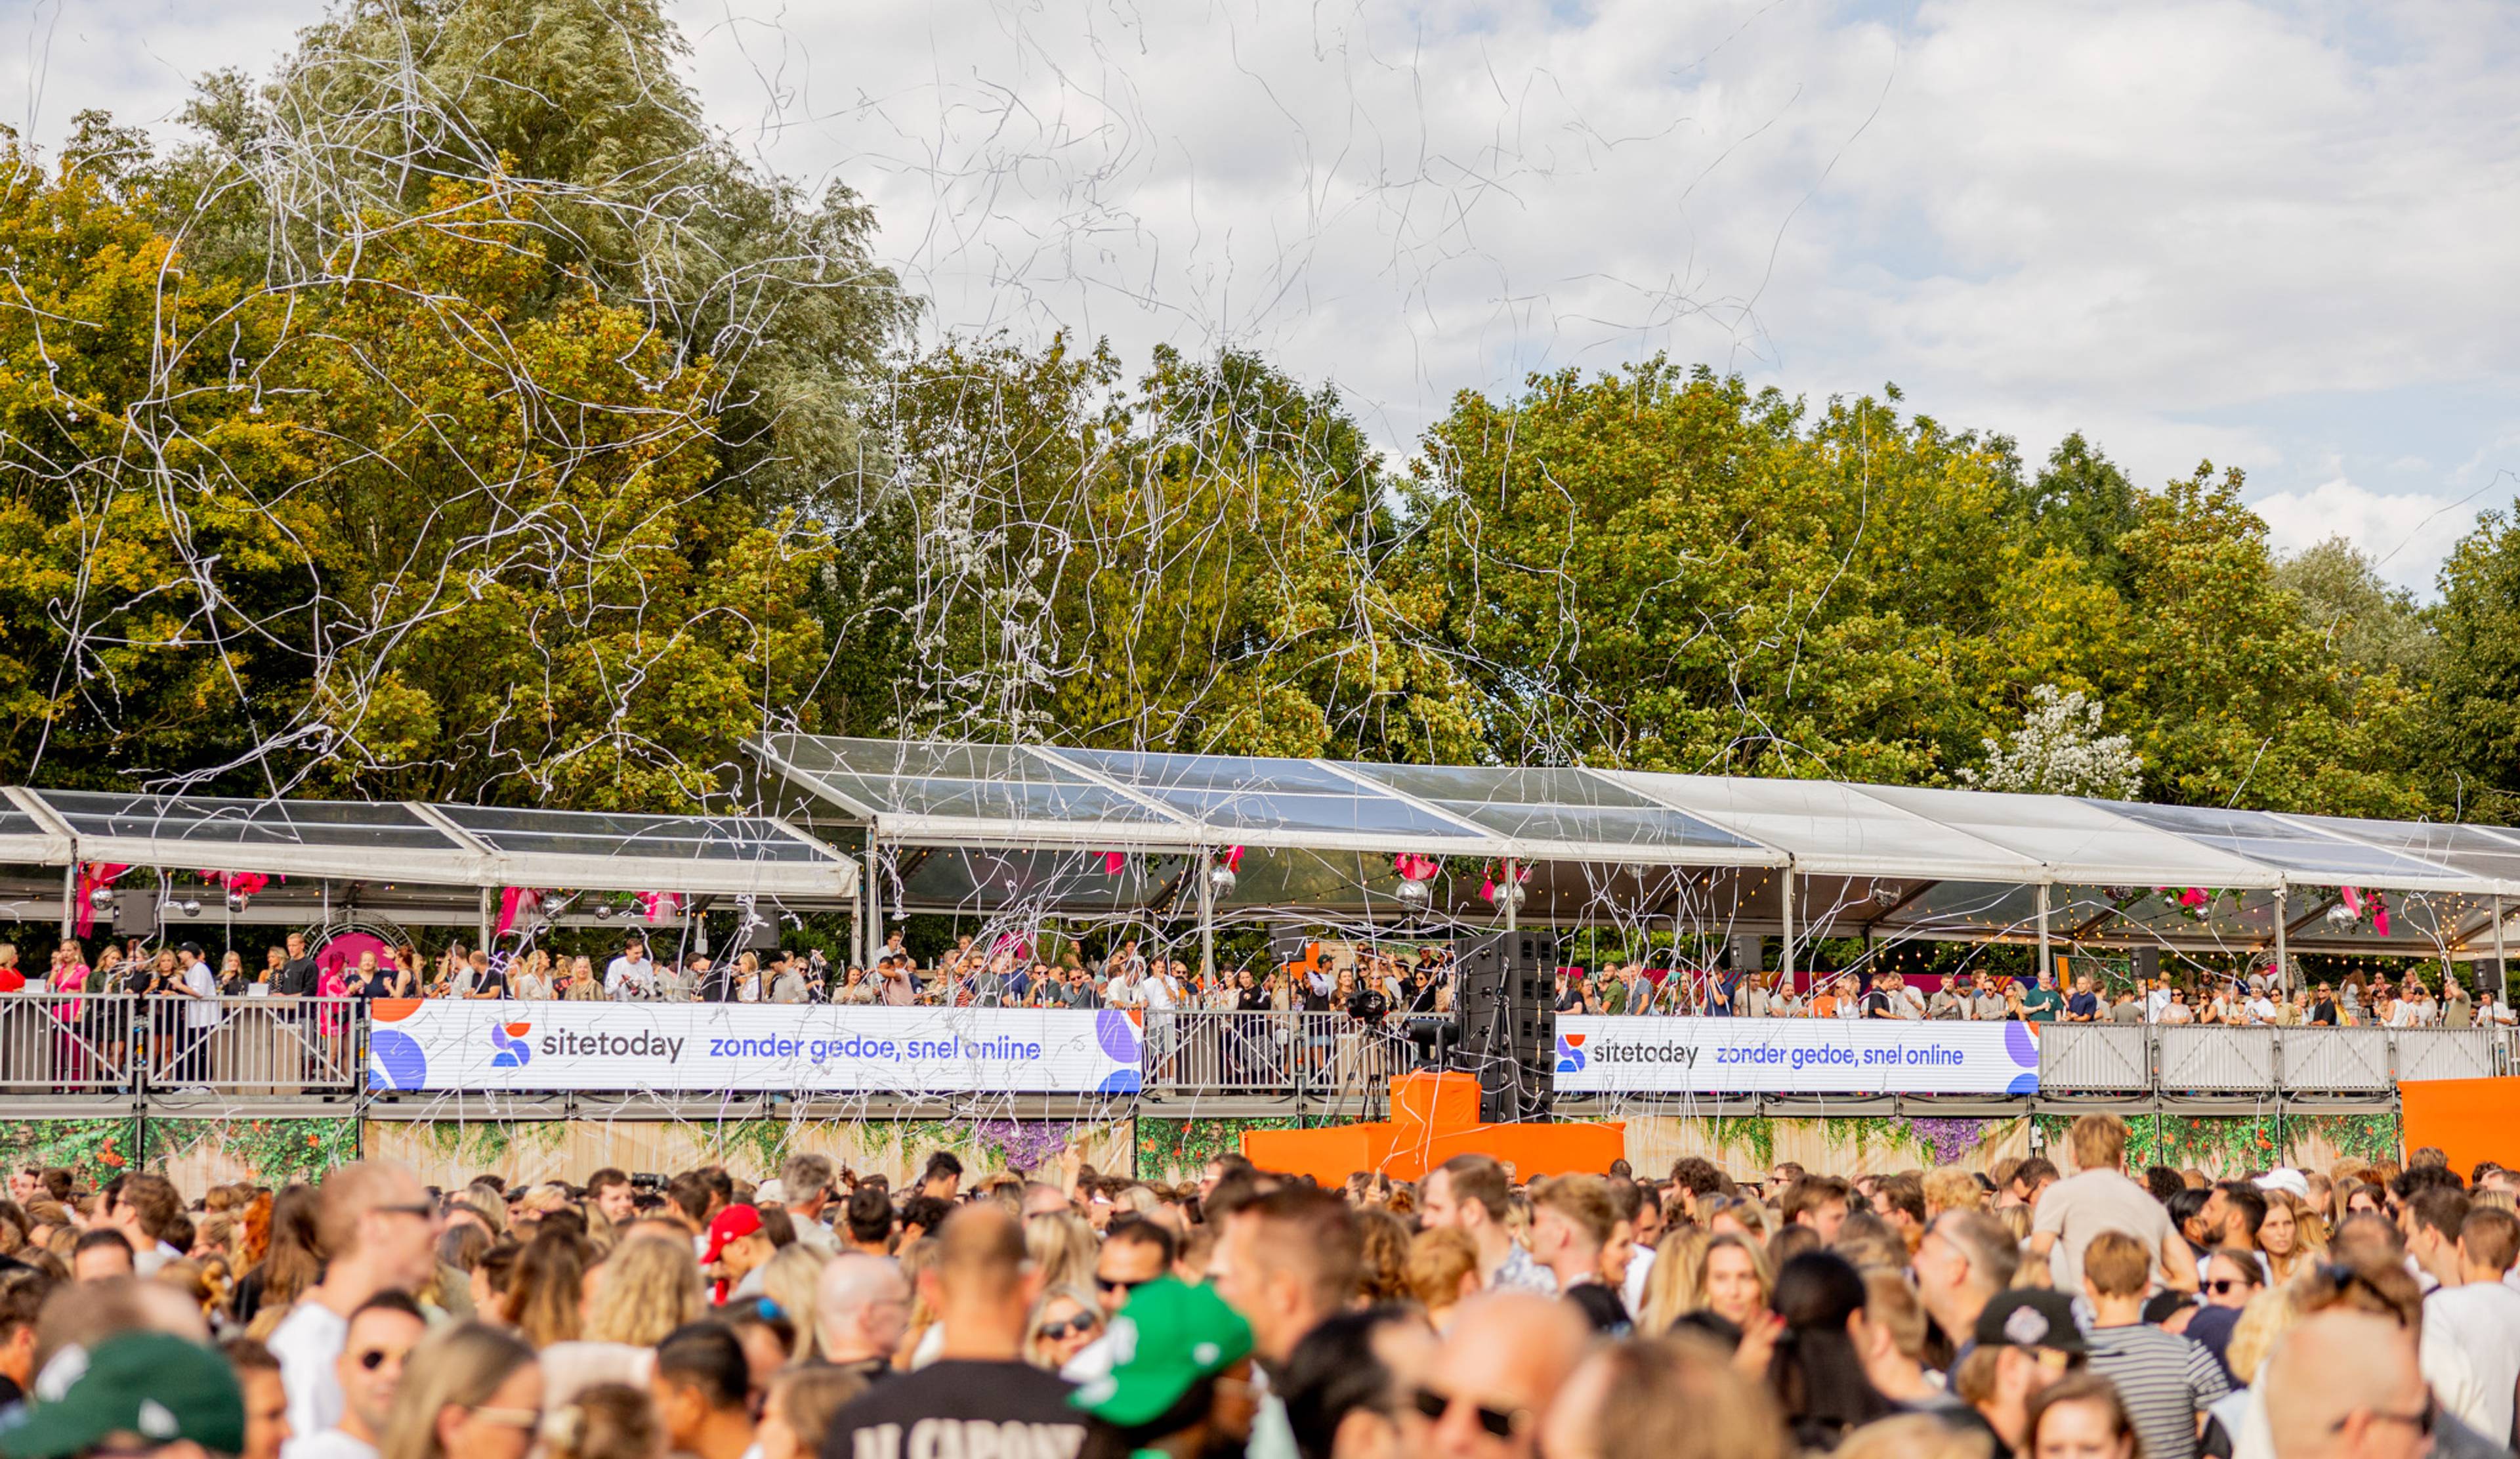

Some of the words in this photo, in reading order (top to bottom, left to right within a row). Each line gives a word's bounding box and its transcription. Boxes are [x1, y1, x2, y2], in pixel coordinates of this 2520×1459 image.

[541, 1028, 684, 1064] sitetoday
[710, 1033, 805, 1057] zonder
[810, 1034, 901, 1065] gedoe,
[908, 1035, 958, 1059] snel
[965, 1035, 1041, 1060] online
[1593, 1038, 1699, 1070] sitetoday
[1717, 1042, 1786, 1064] zonder
[1791, 1044, 1859, 1070] gedoe,
[1864, 1044, 1902, 1065] snel
[1906, 1044, 1964, 1065] online
